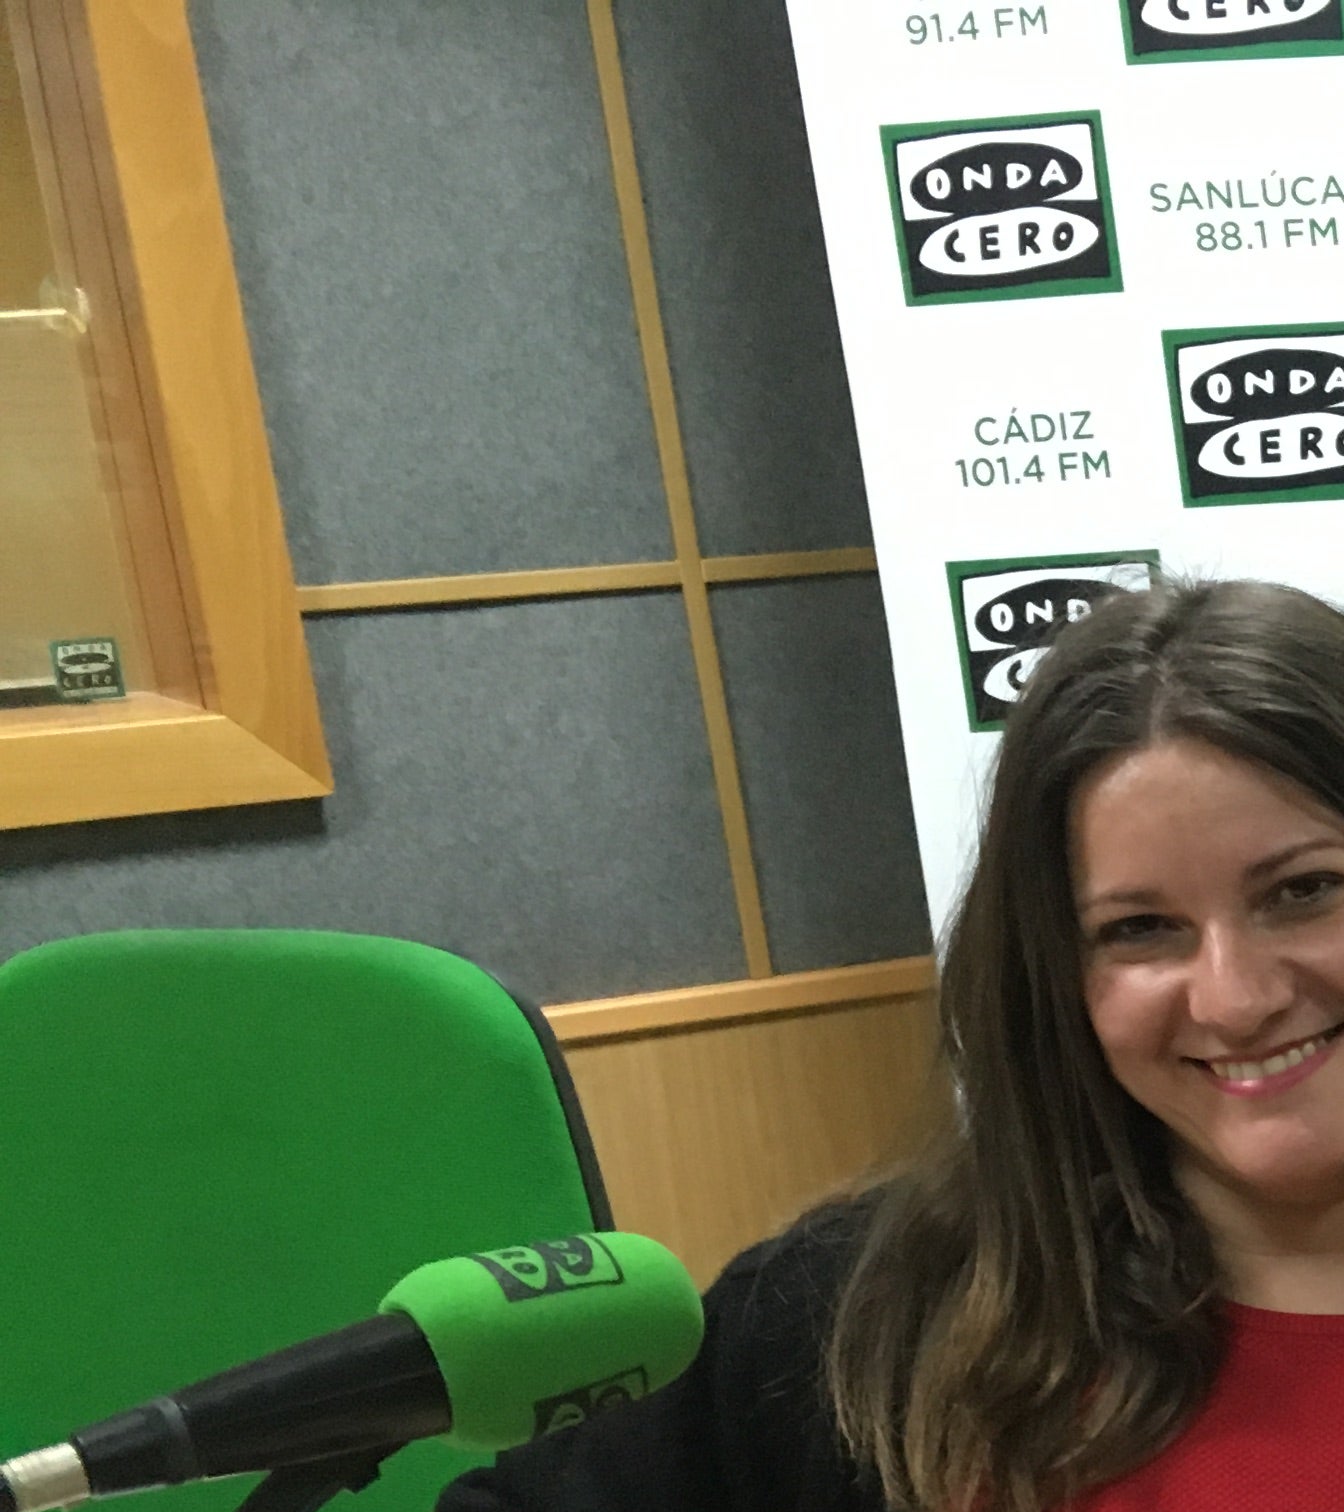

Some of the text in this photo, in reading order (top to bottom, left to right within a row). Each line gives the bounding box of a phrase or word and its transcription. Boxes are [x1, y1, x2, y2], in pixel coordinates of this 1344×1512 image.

[905, 5, 1048, 45] 91.4 FM
[925, 158, 1068, 200] ONDA
[943, 221, 1075, 263] CERO
[1195, 216, 1339, 252] 88.1 FM
[974, 407, 1095, 446] CÁDIZ
[955, 450, 1111, 488] 101.4 FM
[990, 599, 1092, 632] OND
